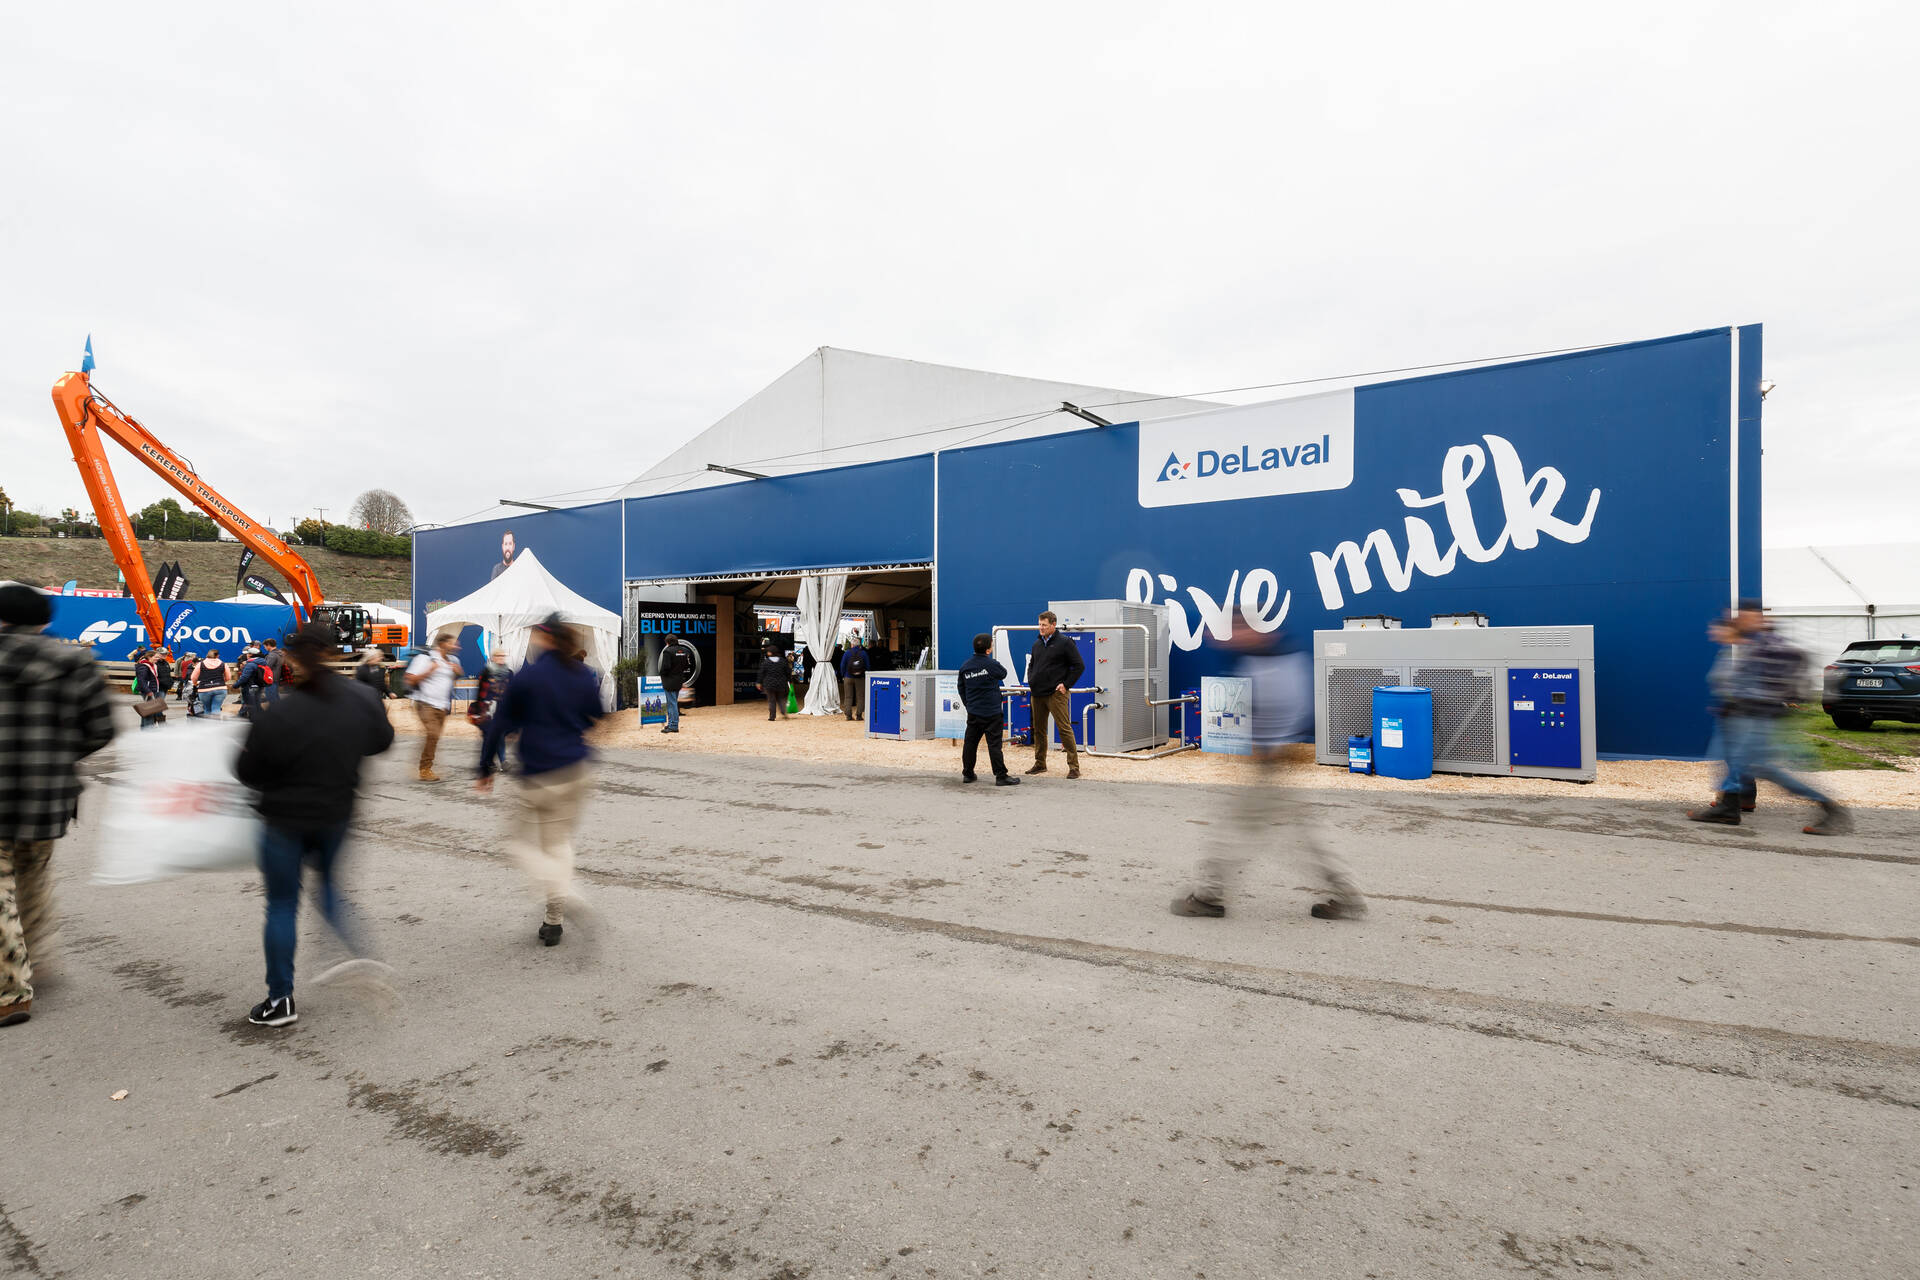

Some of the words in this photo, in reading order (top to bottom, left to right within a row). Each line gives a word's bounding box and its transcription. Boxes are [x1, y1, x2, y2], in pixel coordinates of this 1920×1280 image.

[1197, 434, 1330, 478] DeLaval
[141, 442, 194, 486] KEREPEHI
[197, 485, 251, 530] TRANSPORT
[1310, 434, 1601, 610] milk
[129, 624, 253, 643] TPCON
[171, 608, 193, 629] TOPCON
[640, 619, 681, 634] BLUE
[685, 620, 717, 634] LINE
